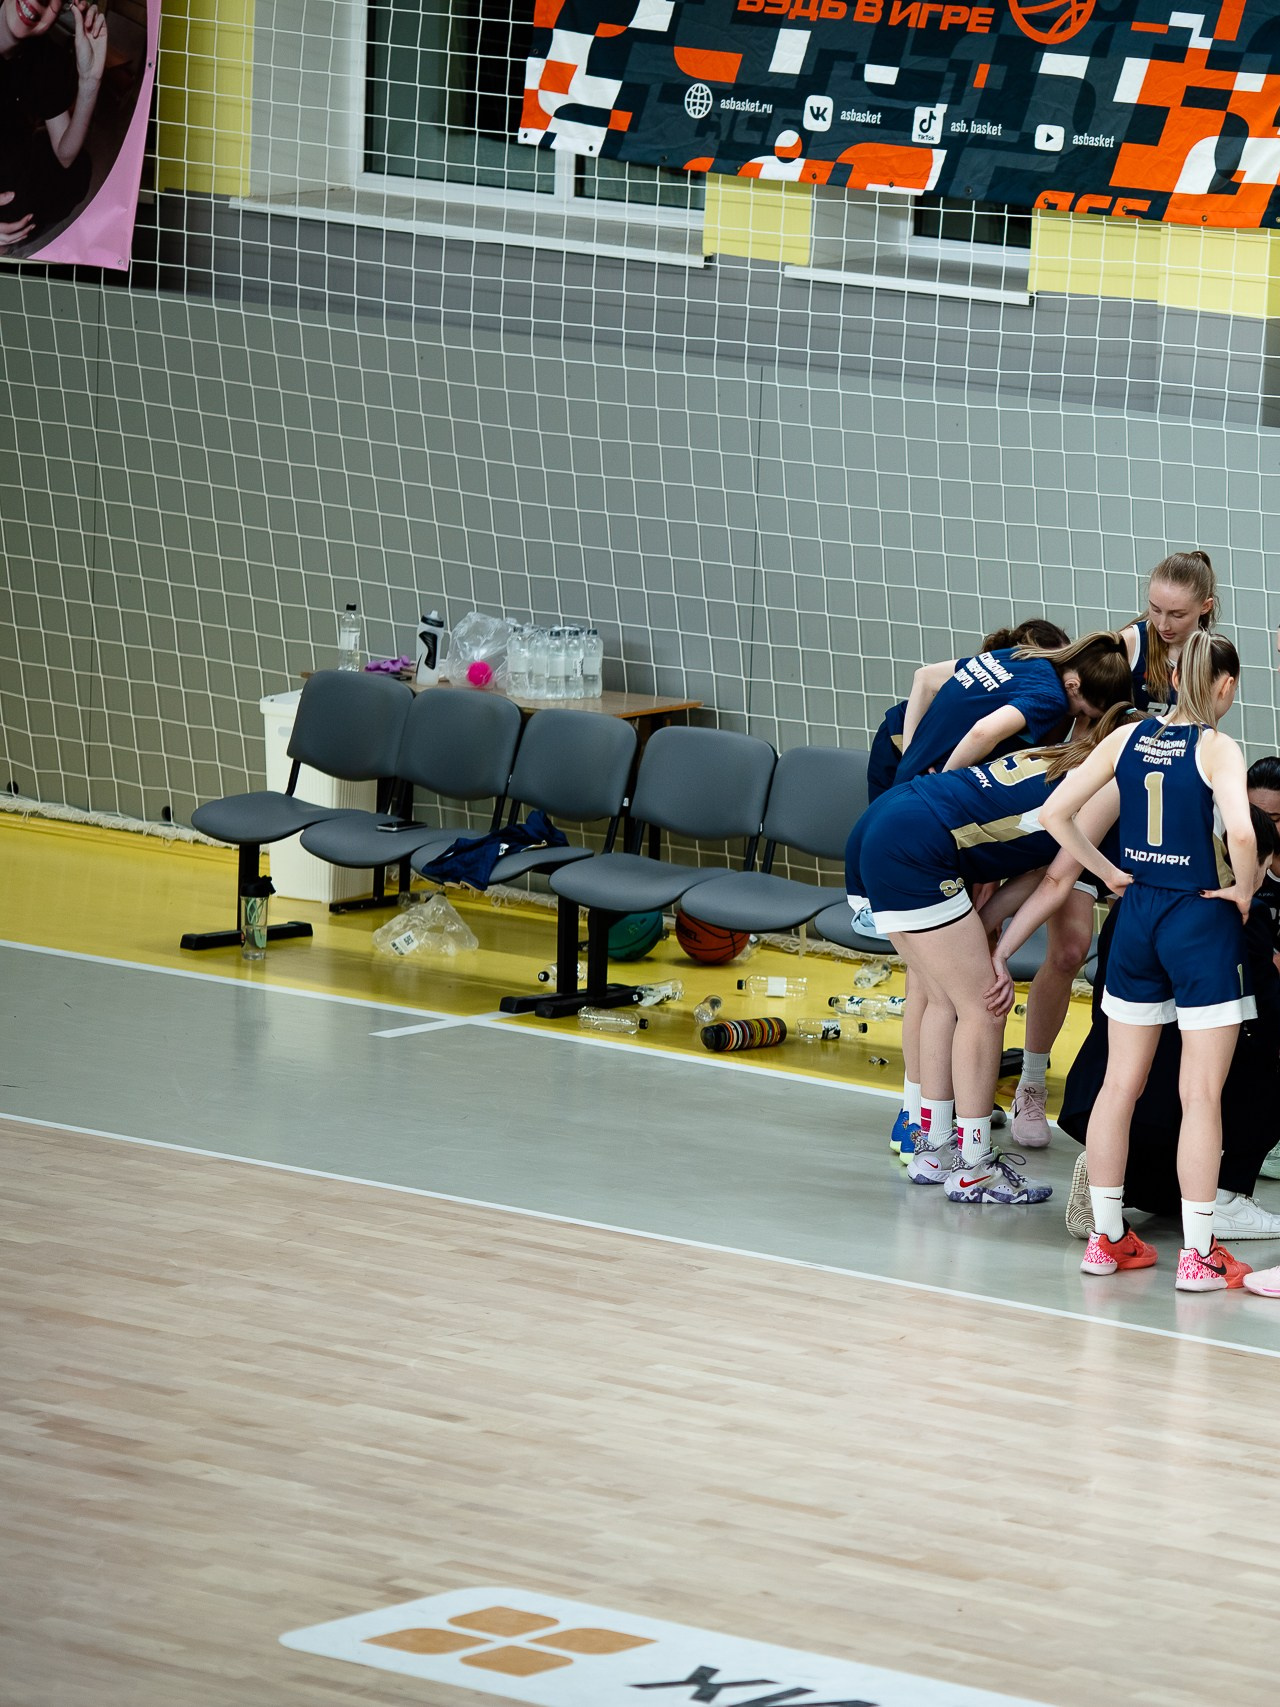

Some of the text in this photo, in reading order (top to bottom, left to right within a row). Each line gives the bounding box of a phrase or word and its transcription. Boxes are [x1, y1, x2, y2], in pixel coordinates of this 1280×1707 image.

[853, 0, 883, 24] В
[888, 2, 995, 34] ИГРЕ
[720, 97, 773, 114] asbasket.ru
[840, 109, 882, 125] asbasket
[917, 134, 935, 142] TikTok
[1072, 133, 1115, 148] asbasket
[1139, 735, 1186, 749] РОССИЙСКИЙ
[1134, 743, 1186, 757] УНИВЕРСИТЕТ
[1142, 754, 1172, 766] СПОРТА
[1144, 771, 1164, 846] 1
[1124, 847, 1191, 866] ГЦОЛИФК
